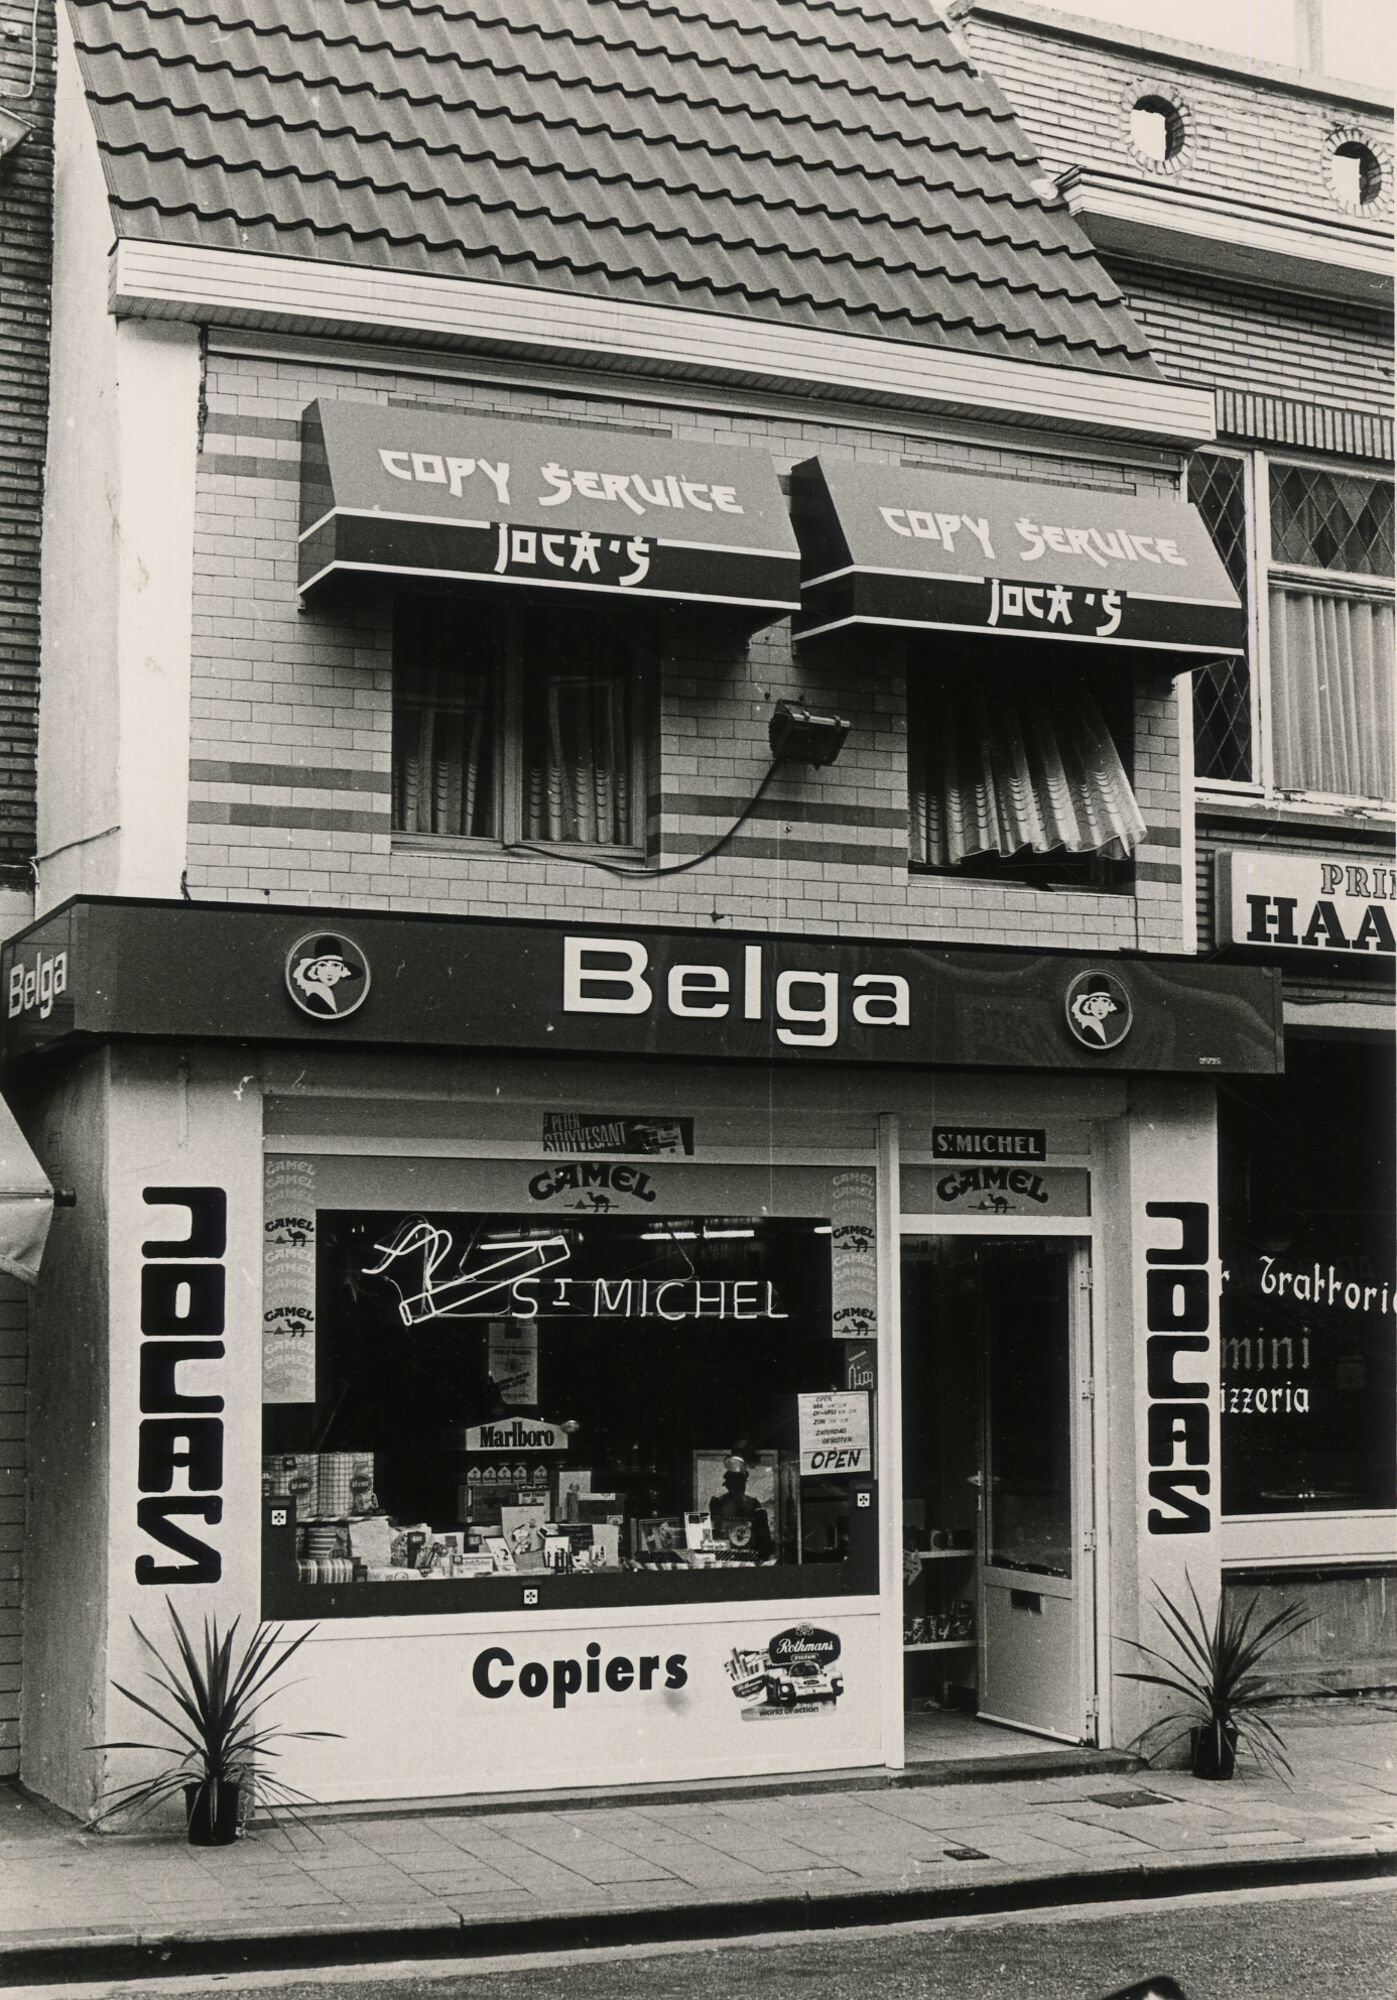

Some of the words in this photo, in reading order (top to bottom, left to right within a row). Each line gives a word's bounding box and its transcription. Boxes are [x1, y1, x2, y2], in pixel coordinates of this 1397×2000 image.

[378, 449, 510, 505] COPY
[879, 506, 996, 560] COPY
[1320, 863, 1395, 900] PRI
[8, 951, 68, 1019] Belga
[563, 936, 911, 1047] Belga
[545, 1121, 627, 1152] STUYVESANT
[552, 1113, 581, 1131] PETER
[528, 1164, 656, 1202] CAMEL
[937, 1166, 1048, 1203] CAMEL
[264, 1218, 315, 1233] CAMEL
[832, 1225, 876, 1239] CAMEL
[593, 1279, 789, 1320] MICHEL
[1259, 1255, 1395, 1314] Trattori
[264, 1307, 315, 1322] CAMEL
[833, 1308, 877, 1322] CAMEL
[135, 1187, 226, 1585] JOCAS
[1146, 1202, 1211, 1535] JOCAS
[1219, 1382, 1310, 1413] izzeria
[480, 1421, 555, 1447] Marlboro
[810, 1448, 861, 1470] OPEN
[776, 1637, 834, 1654] Rothmans
[473, 1642, 688, 1709] Copiers
[759, 1708, 784, 1717] world
[793, 1706, 820, 1714] action
